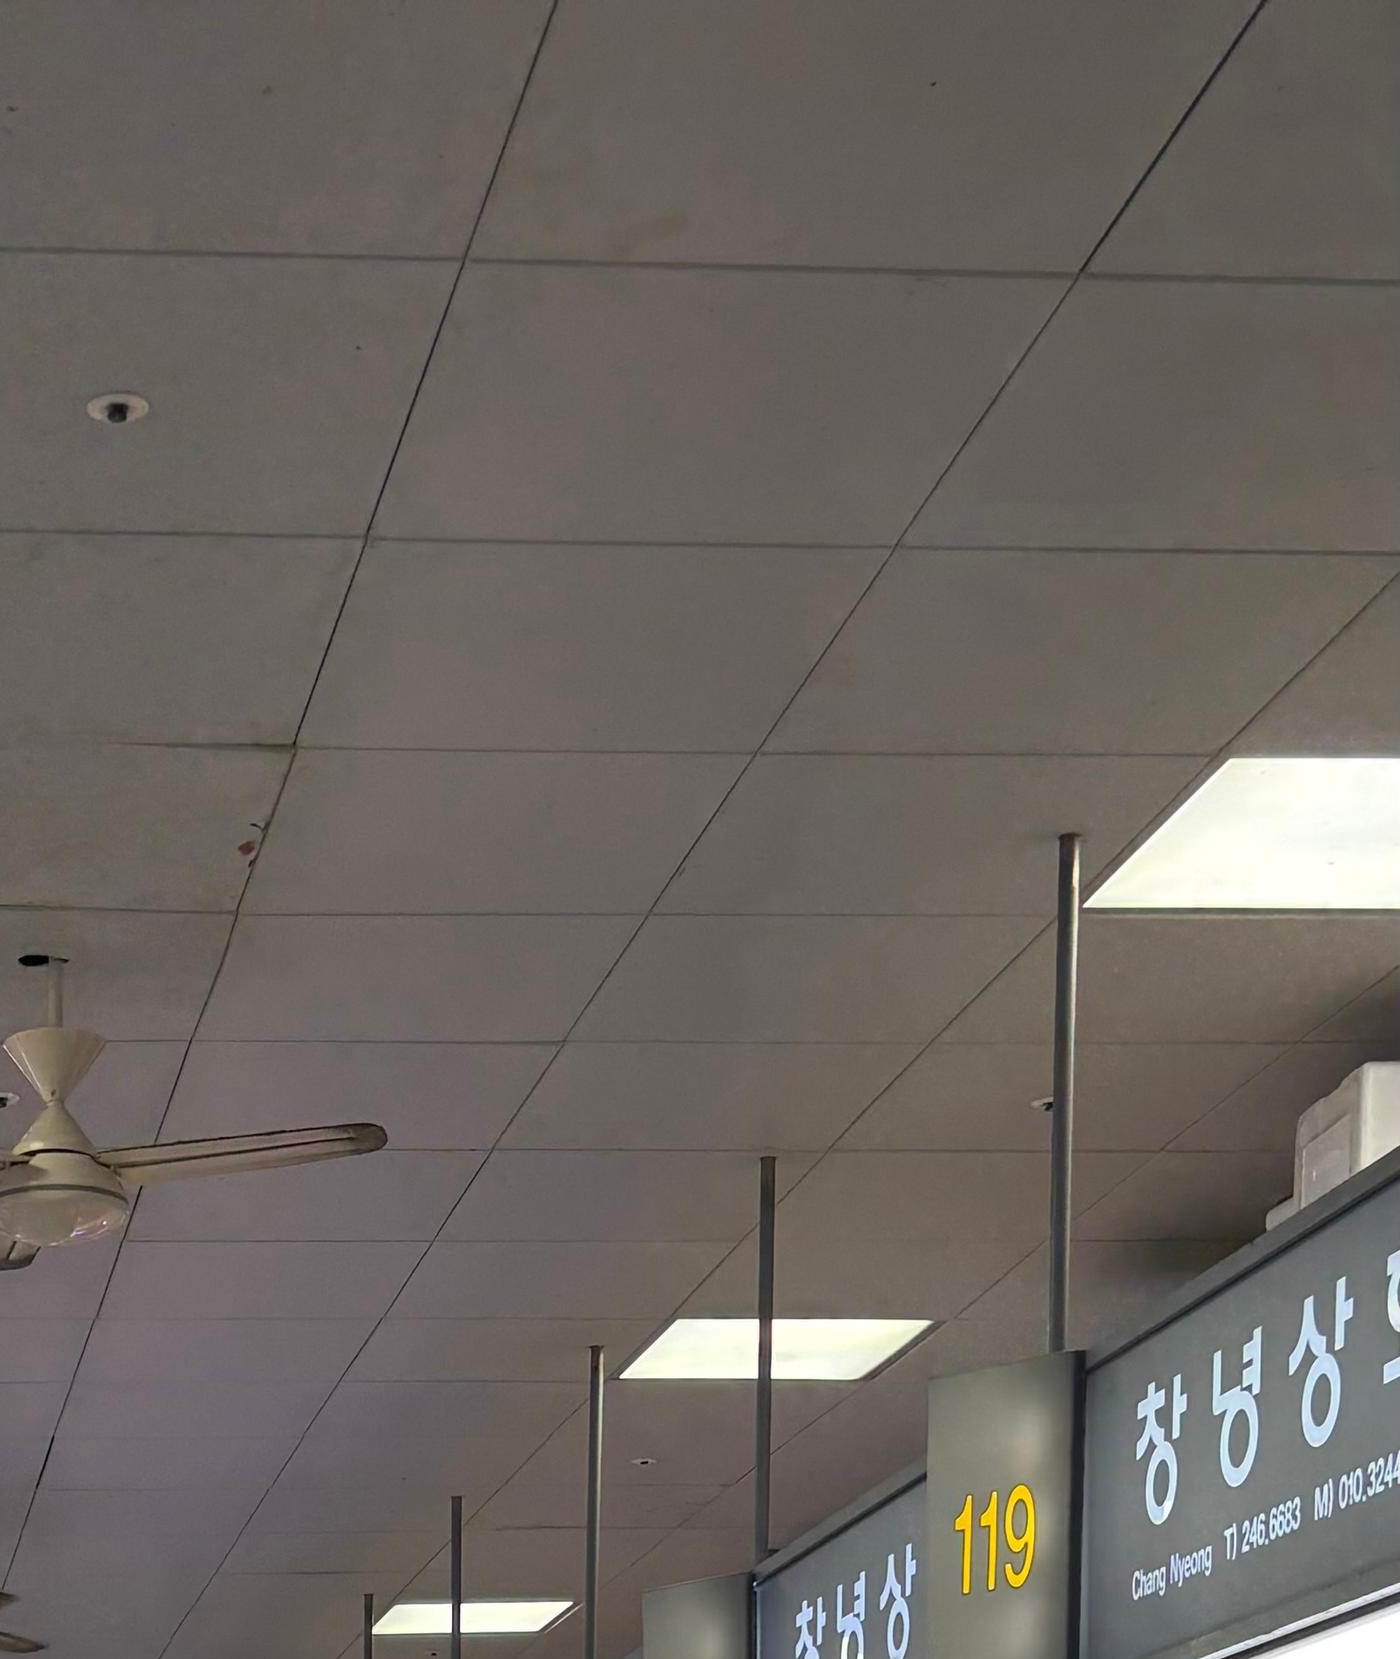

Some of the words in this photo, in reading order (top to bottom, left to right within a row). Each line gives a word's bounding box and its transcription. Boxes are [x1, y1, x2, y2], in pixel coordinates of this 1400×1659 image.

[953, 1483, 1036, 1596] 119
[1132, 1565, 1166, 1600] Chang
[1170, 1545, 1212, 1587] Nyeong
